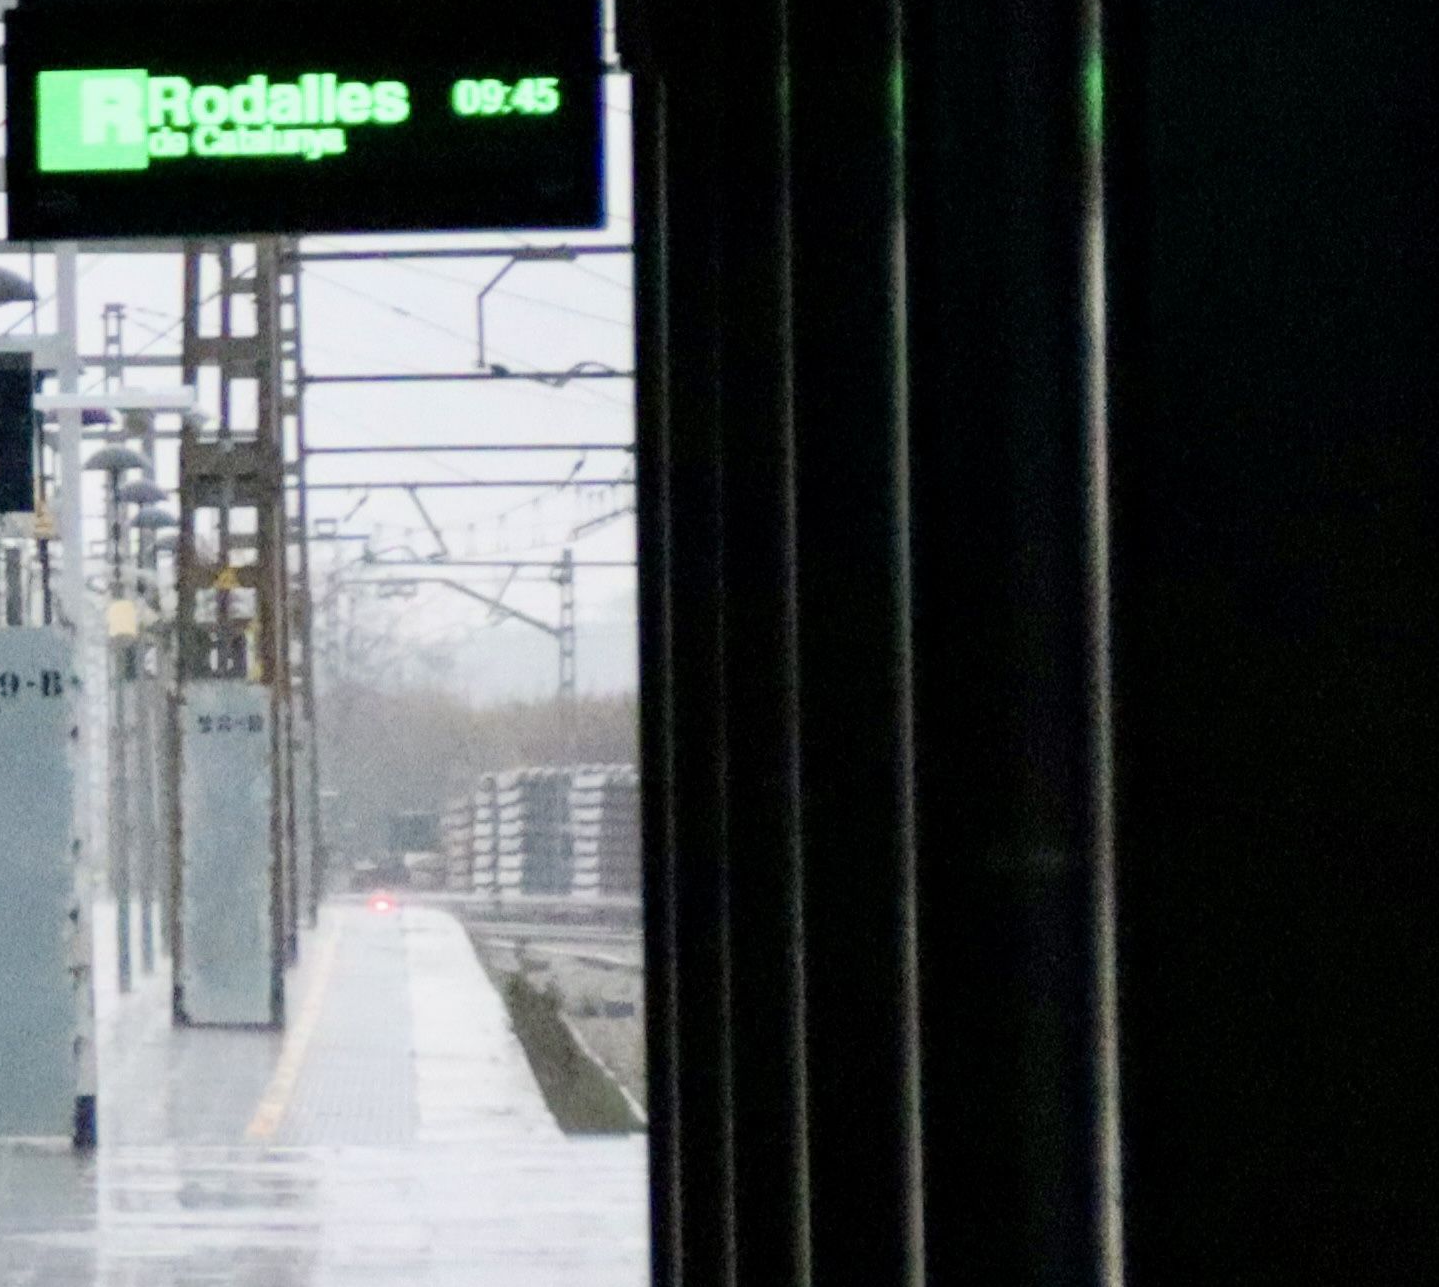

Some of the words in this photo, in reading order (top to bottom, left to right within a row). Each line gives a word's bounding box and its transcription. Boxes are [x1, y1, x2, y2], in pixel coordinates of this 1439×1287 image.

[148, 73, 410, 127] Rodalles
[452, 78, 560, 115] 09:45
[148, 124, 188, 156] de
[192, 123, 348, 161] Catalunya
